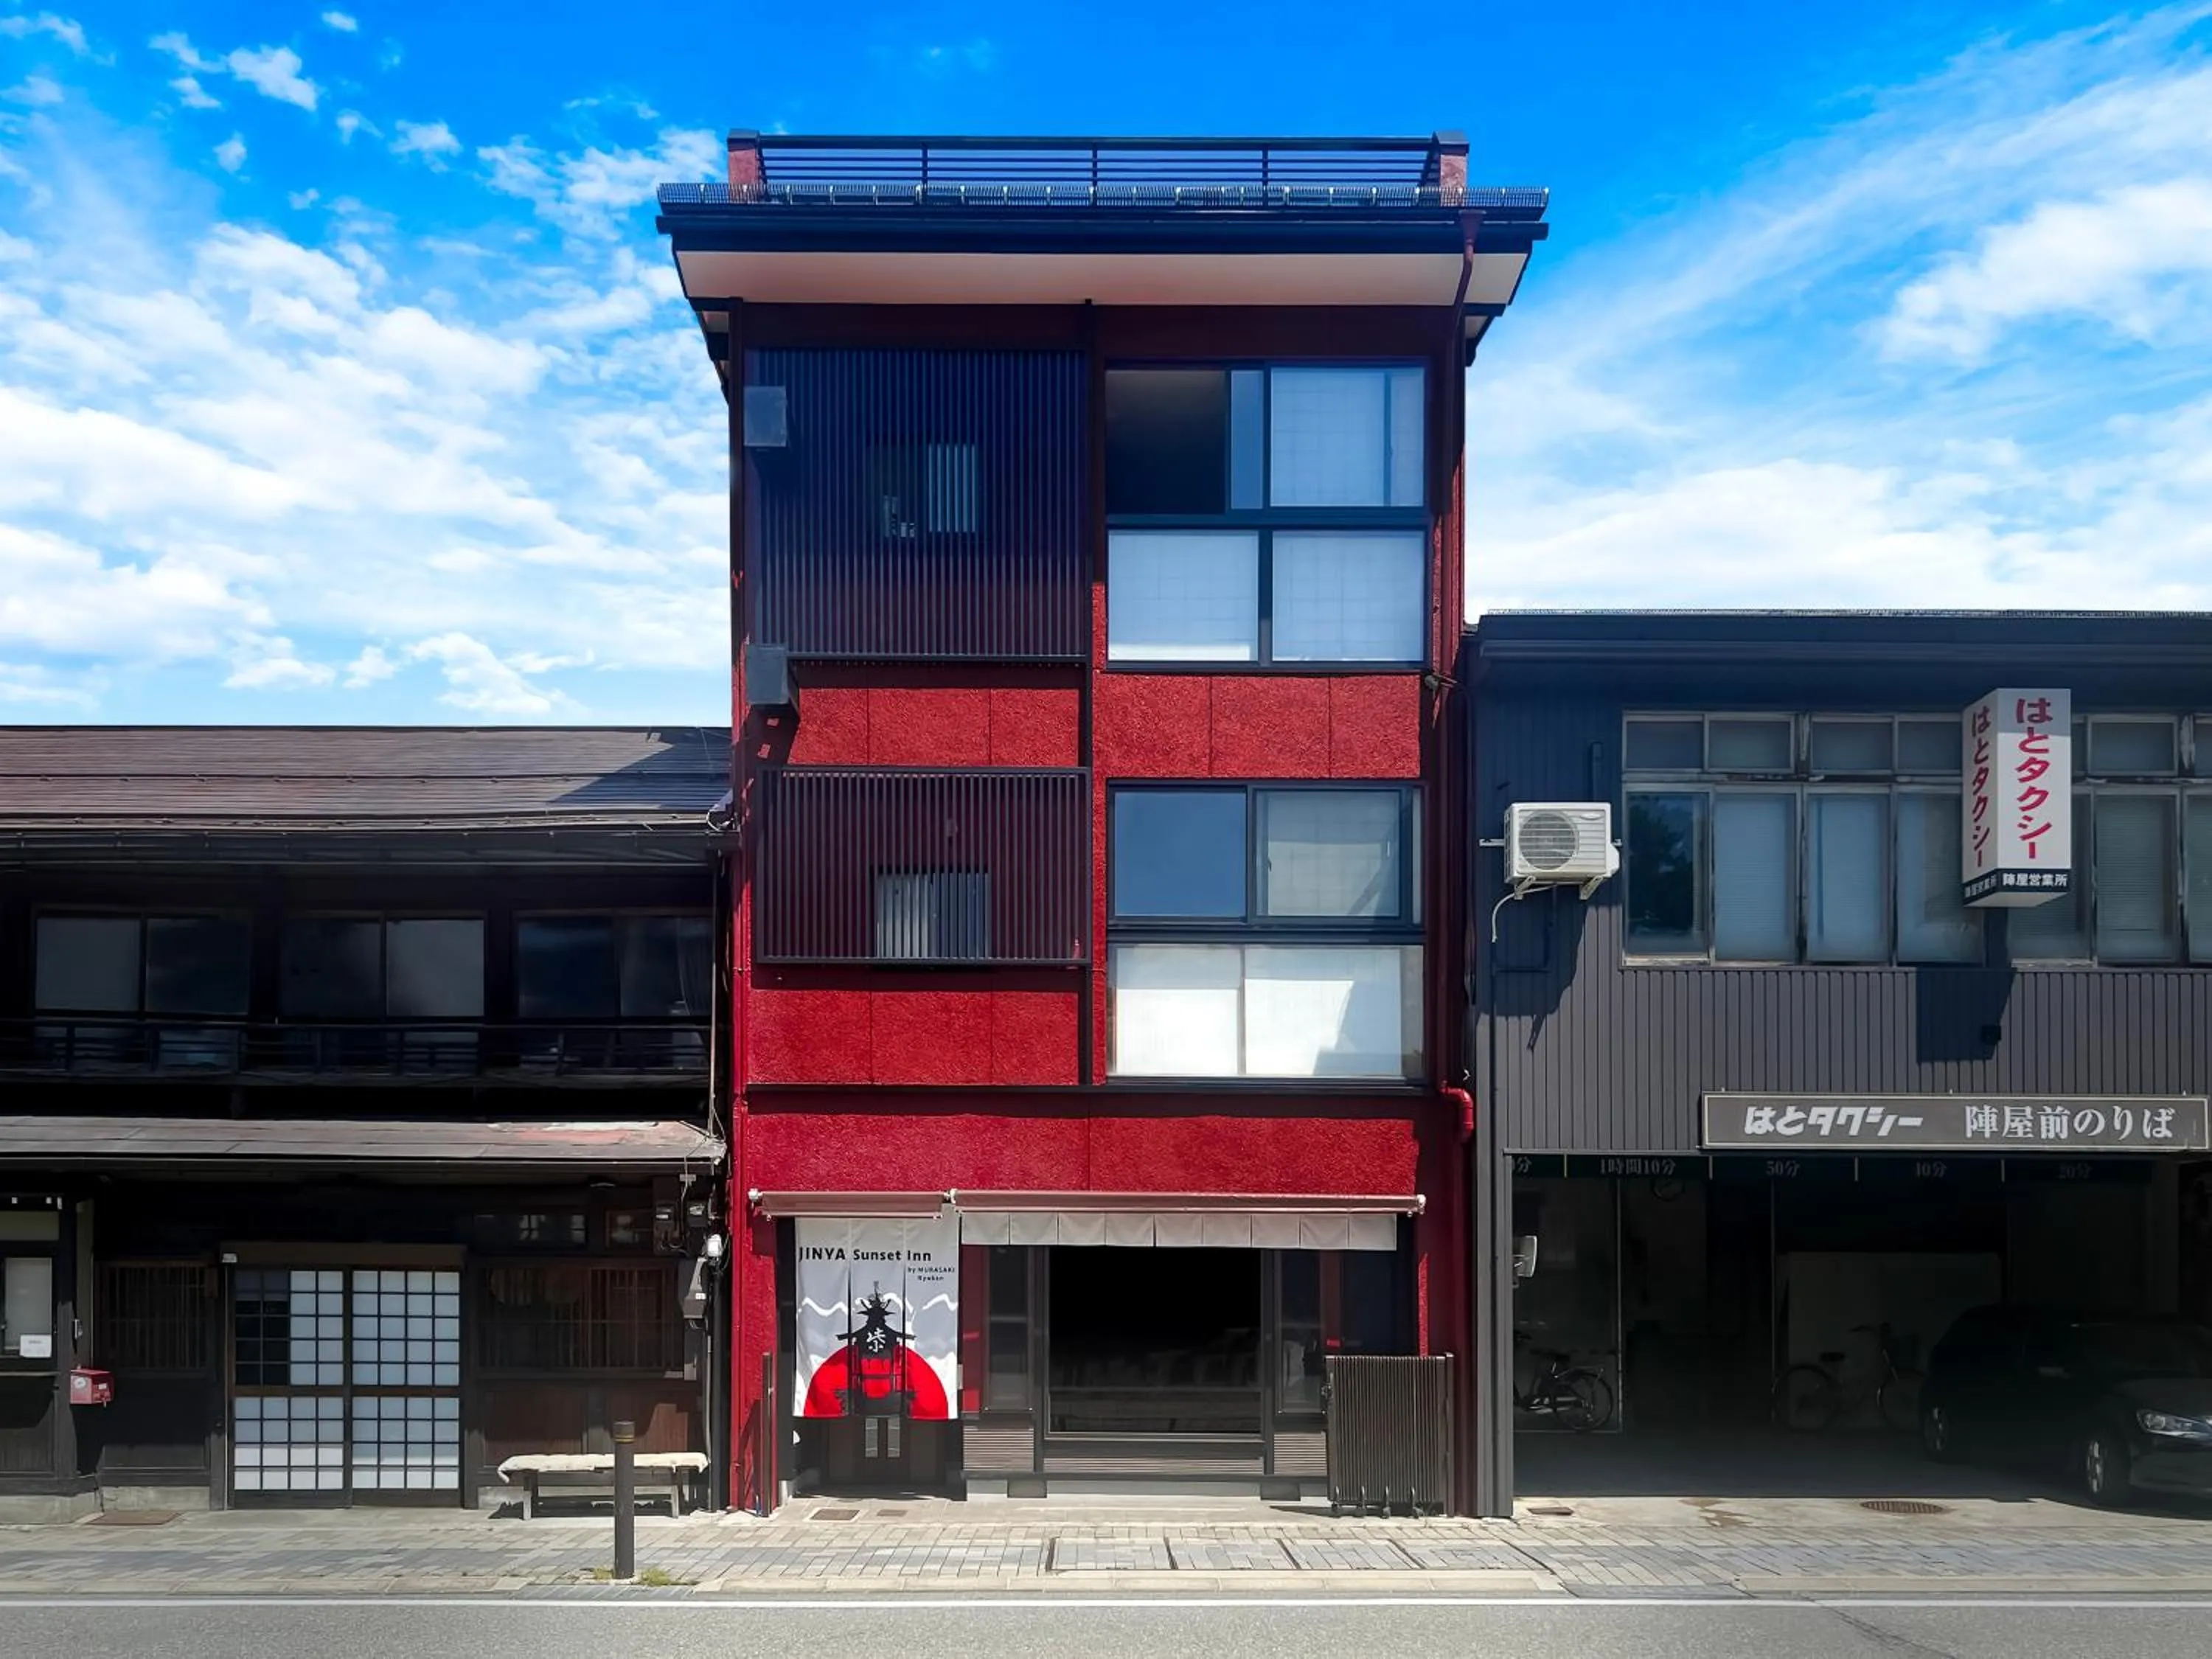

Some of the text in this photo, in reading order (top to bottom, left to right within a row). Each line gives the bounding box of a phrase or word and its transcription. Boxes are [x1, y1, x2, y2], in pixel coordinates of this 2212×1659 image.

[1971, 706, 1991, 867] はとタクシー
[2014, 698, 2053, 859] はとタクシー
[2002, 873, 2068, 887] 陣屋営業所
[1745, 1105, 2175, 1141] はとタクシー 陣屋前のりば
[799, 1246, 932, 1262] JINYA Sunset Inn
